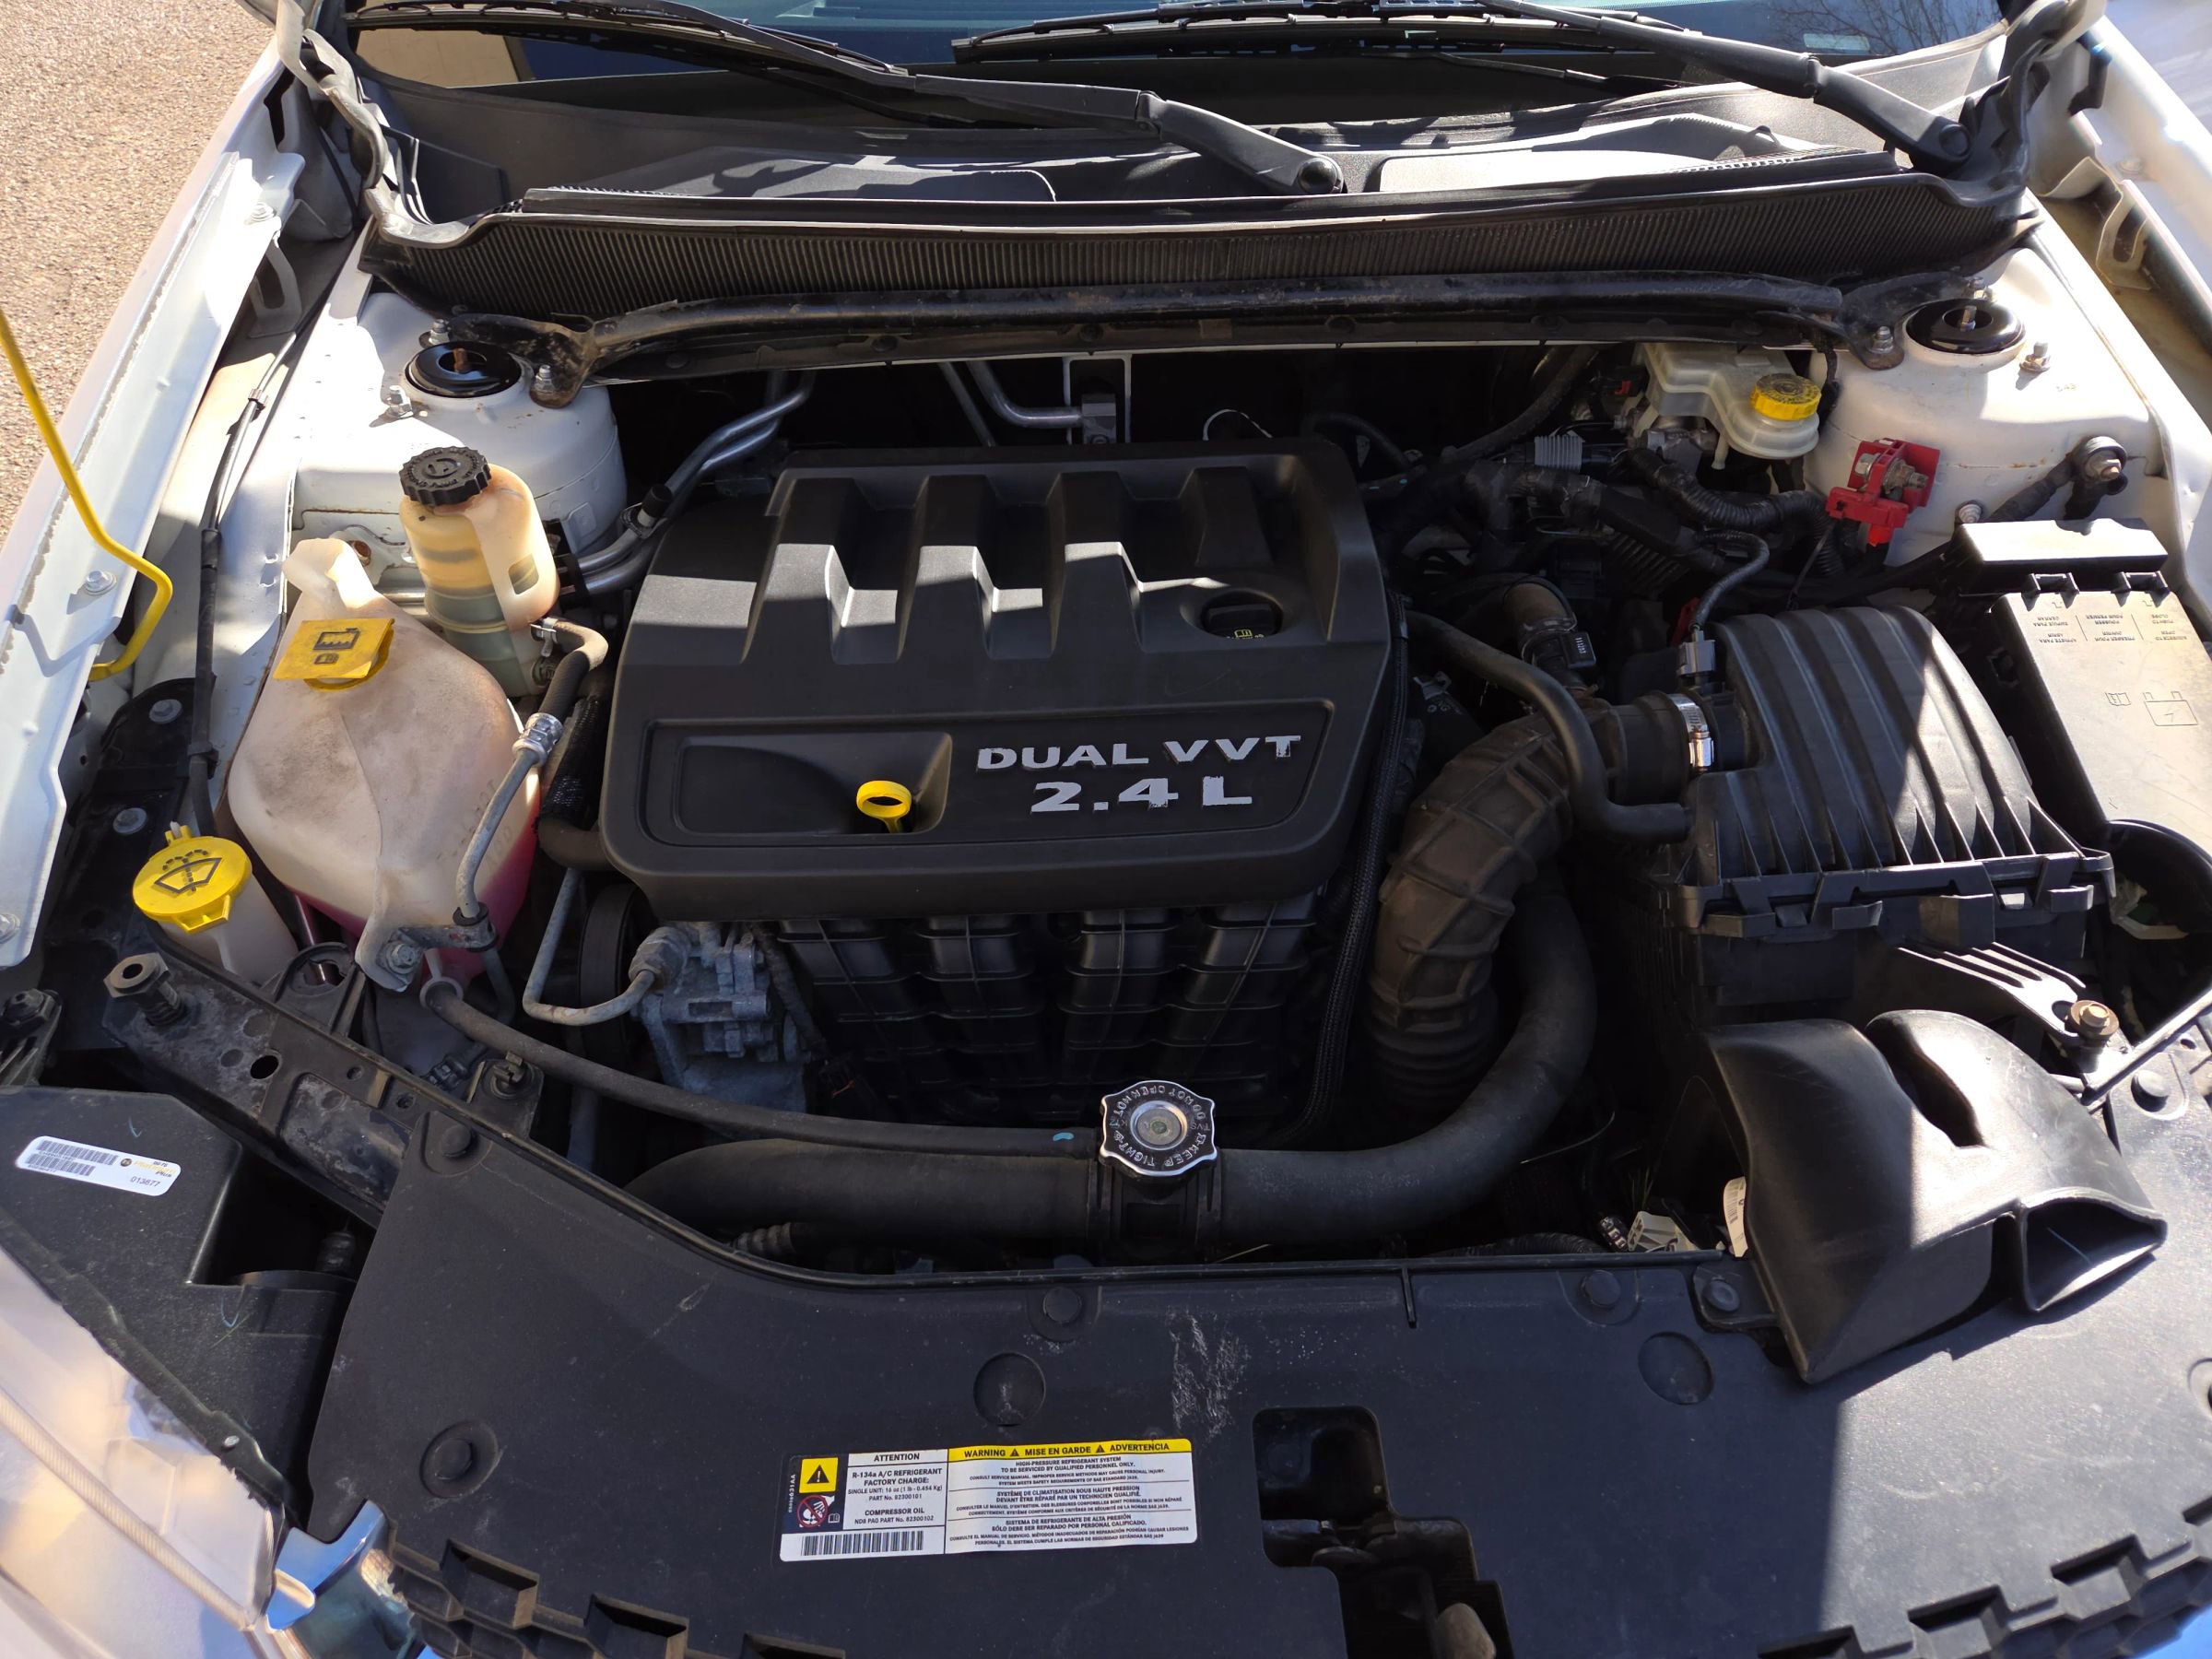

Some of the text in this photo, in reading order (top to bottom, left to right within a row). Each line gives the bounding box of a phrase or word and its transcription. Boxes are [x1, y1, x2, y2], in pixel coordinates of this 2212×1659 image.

[977, 735, 1301, 769] DUAL VVT
[1030, 776, 1253, 813] 2.4 L
[1113, 1086, 1206, 1121] DO NOT OPEN HOT
[1119, 1143, 1199, 1167] KEEP TIGHT
[1025, 1447, 1046, 1456] MISE
[1062, 1446, 1091, 1454] GARDE
[1110, 1443, 1170, 1452] ADVERTENCIA
[874, 1453, 920, 1462] ATTENTION
[964, 1449, 1006, 1457] WARNING
[877, 1470, 892, 1478] A/C
[894, 1467, 942, 1477] REFRIGERANT
[898, 1477, 929, 1485] CHARGE:
[900, 1486, 906, 1494] (1
[865, 1508, 911, 1516] COMPRESSOR
